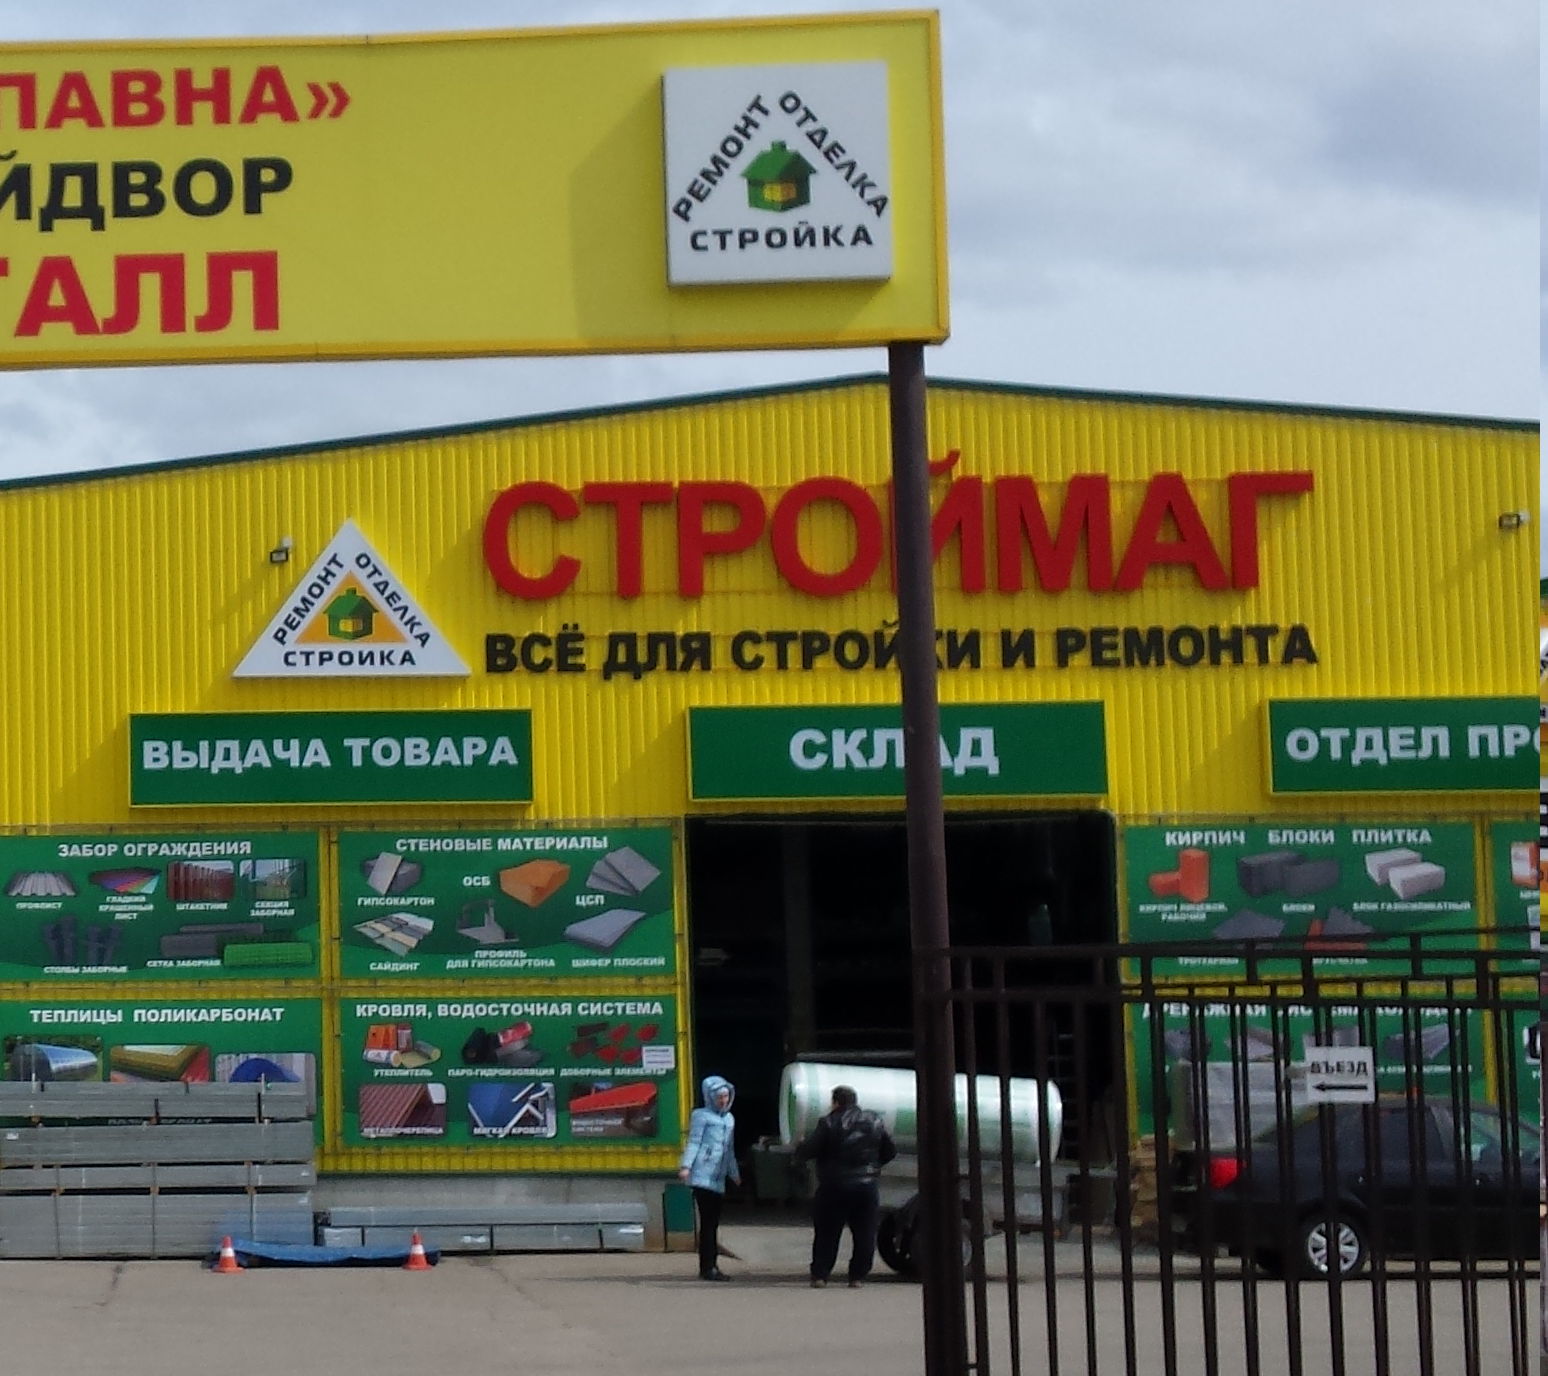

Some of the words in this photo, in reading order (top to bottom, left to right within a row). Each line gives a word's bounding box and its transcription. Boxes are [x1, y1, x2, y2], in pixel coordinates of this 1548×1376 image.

[672, 94, 771, 223] РЕМОНТ
[778, 90, 890, 218] ОТДЕЛКА
[690, 221, 873, 252] СТРОЙКА
[272, 552, 344, 646] РЕМОНТ
[354, 552, 432, 648] ОТДЕЛКА
[485, 624, 586, 673] ВСЁ
[602, 631, 712, 680] ДЛЯ
[731, 619, 981, 670] СТРОЙИ
[1001, 628, 1036, 670] И
[1056, 625, 1319, 667] РЕМОНТА
[142, 738, 332, 775] ВЫДАЧА
[343, 736, 520, 768] ТОВАРА
[788, 726, 1001, 777] СКЛД
[1285, 724, 1451, 766] ОТДЕЛ
[1468, 724, 1540, 758] ПР
[58, 843, 119, 858] ЗАБОР
[123, 841, 252, 857] ОГРАЖДЕНИЯ
[395, 838, 492, 852] СТЕНОВЫЕ
[497, 836, 608, 851] МАТЕРИАЛЫ
[1165, 830, 1246, 846] КИРПИЧ
[1268, 829, 1335, 845] БЛОКИ
[1352, 829, 1432, 845] ПЛИТКА
[463, 876, 491, 887] ОСБ
[357, 896, 435, 907] ГИПСОКАРТОН
[575, 894, 605, 907] ЦСП
[29, 1009, 123, 1025] ТЕПЛИЦЫ
[133, 1007, 285, 1023] ПОЛИКАРБОНАТ
[355, 1004, 432, 1019] КРОВЛЯ,
[437, 1002, 572, 1018] ВОДОСТОЧНАЯ
[577, 1001, 664, 1016] СИСТЕМА
[1310, 1061, 1369, 1076] ВЪЕЗД
